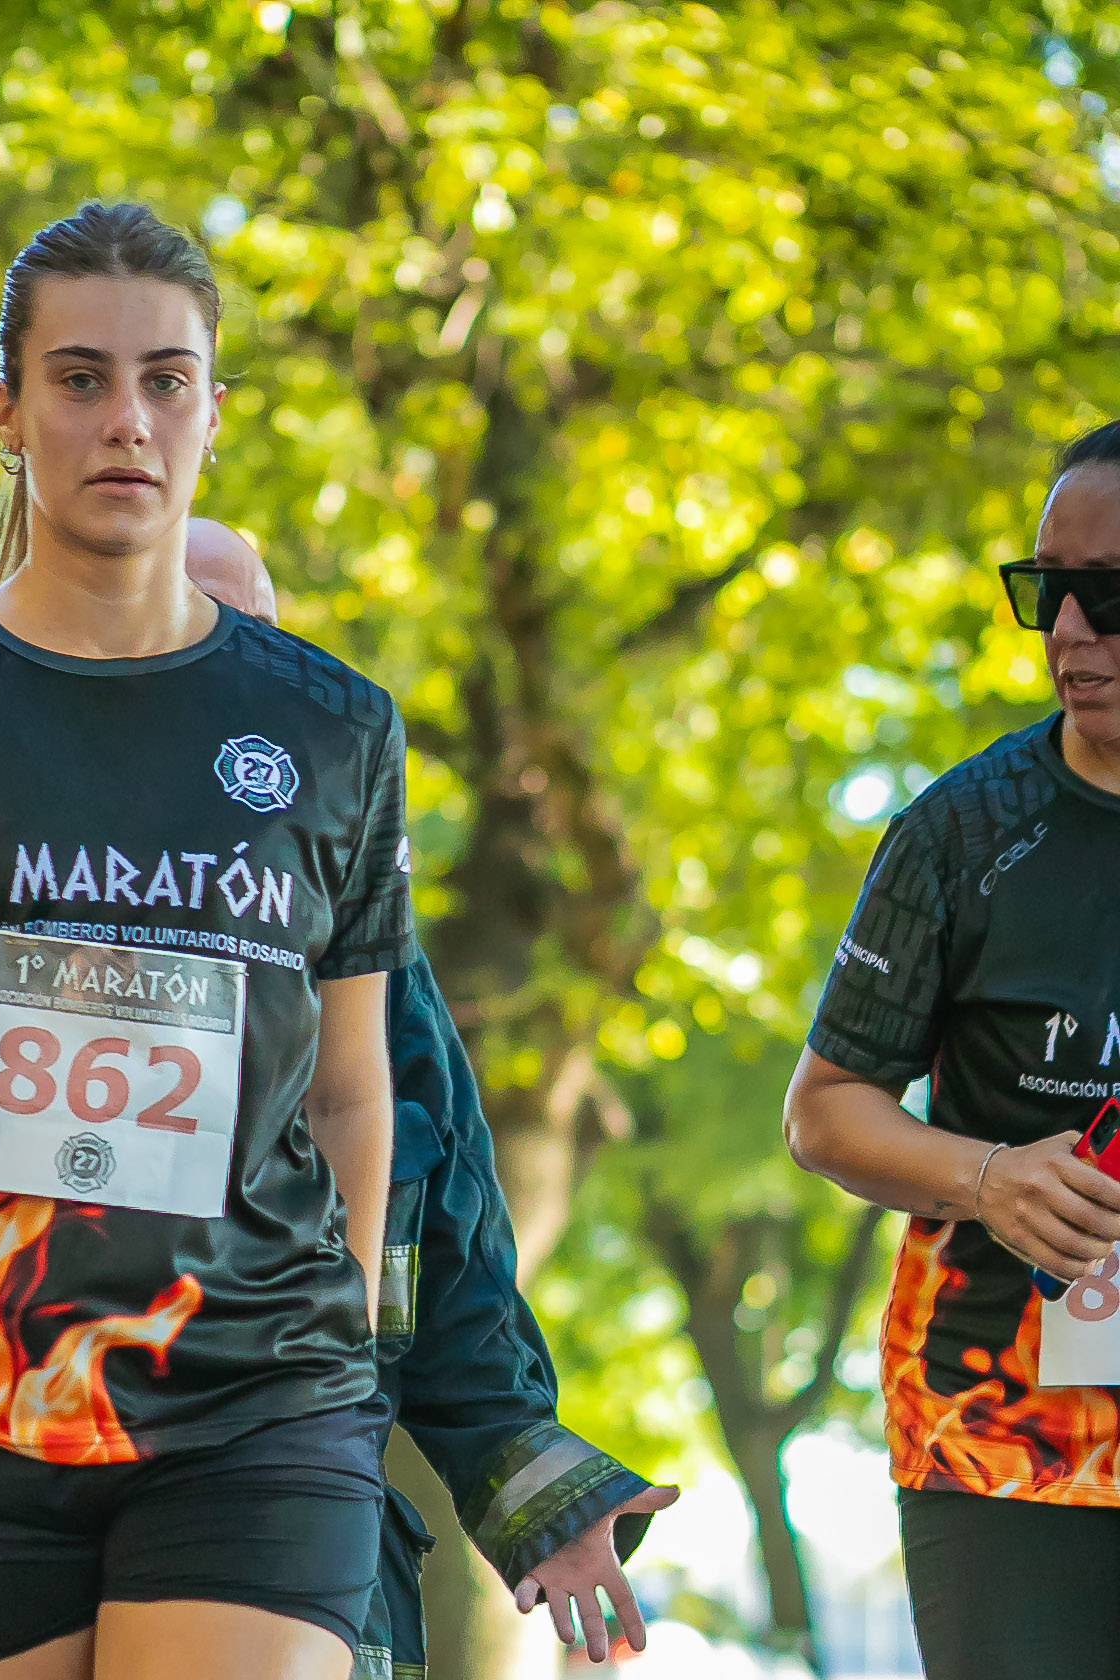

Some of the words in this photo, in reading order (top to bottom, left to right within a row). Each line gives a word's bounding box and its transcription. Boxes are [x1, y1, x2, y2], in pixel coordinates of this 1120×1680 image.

[242, 756, 274, 782] 27
[10, 841, 294, 928] MARATÓN
[121, 925, 237, 954] VOLUNTARIOS
[239, 938, 305, 971] ROSARIO
[52, 960, 209, 1006] MARATÓN
[1018, 1073, 1108, 1098] ASOCIACIÓN
[74, 1150, 99, 1171] 27
